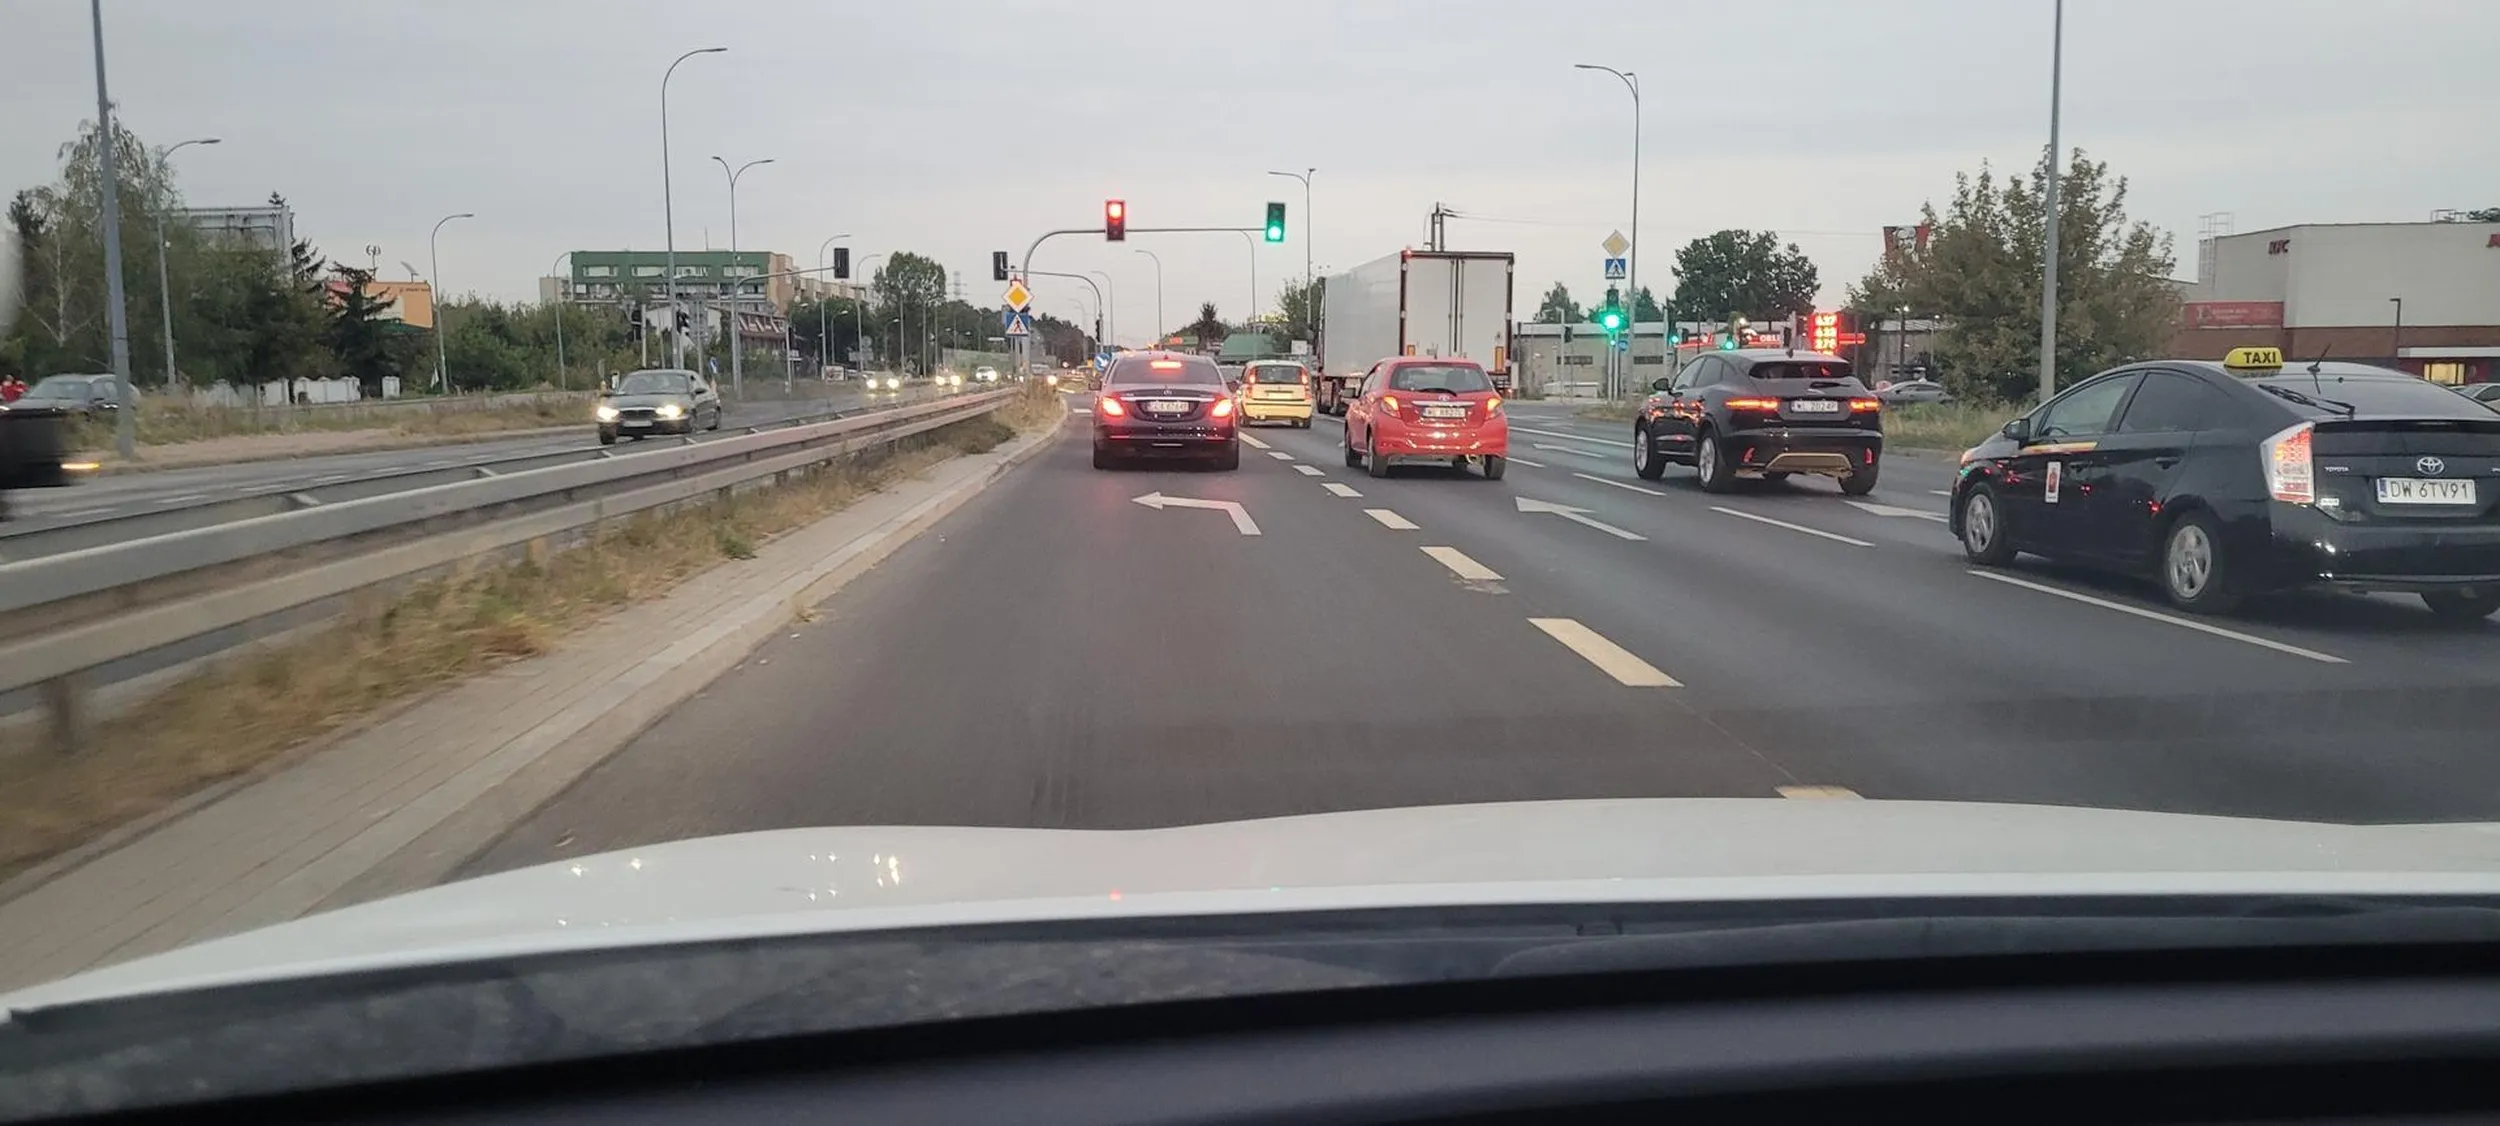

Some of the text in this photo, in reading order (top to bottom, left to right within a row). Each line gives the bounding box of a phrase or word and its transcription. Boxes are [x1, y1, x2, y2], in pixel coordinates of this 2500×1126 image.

[2243, 351, 2276, 363] TAXI
[2390, 481, 2468, 498] DW 6TV91
